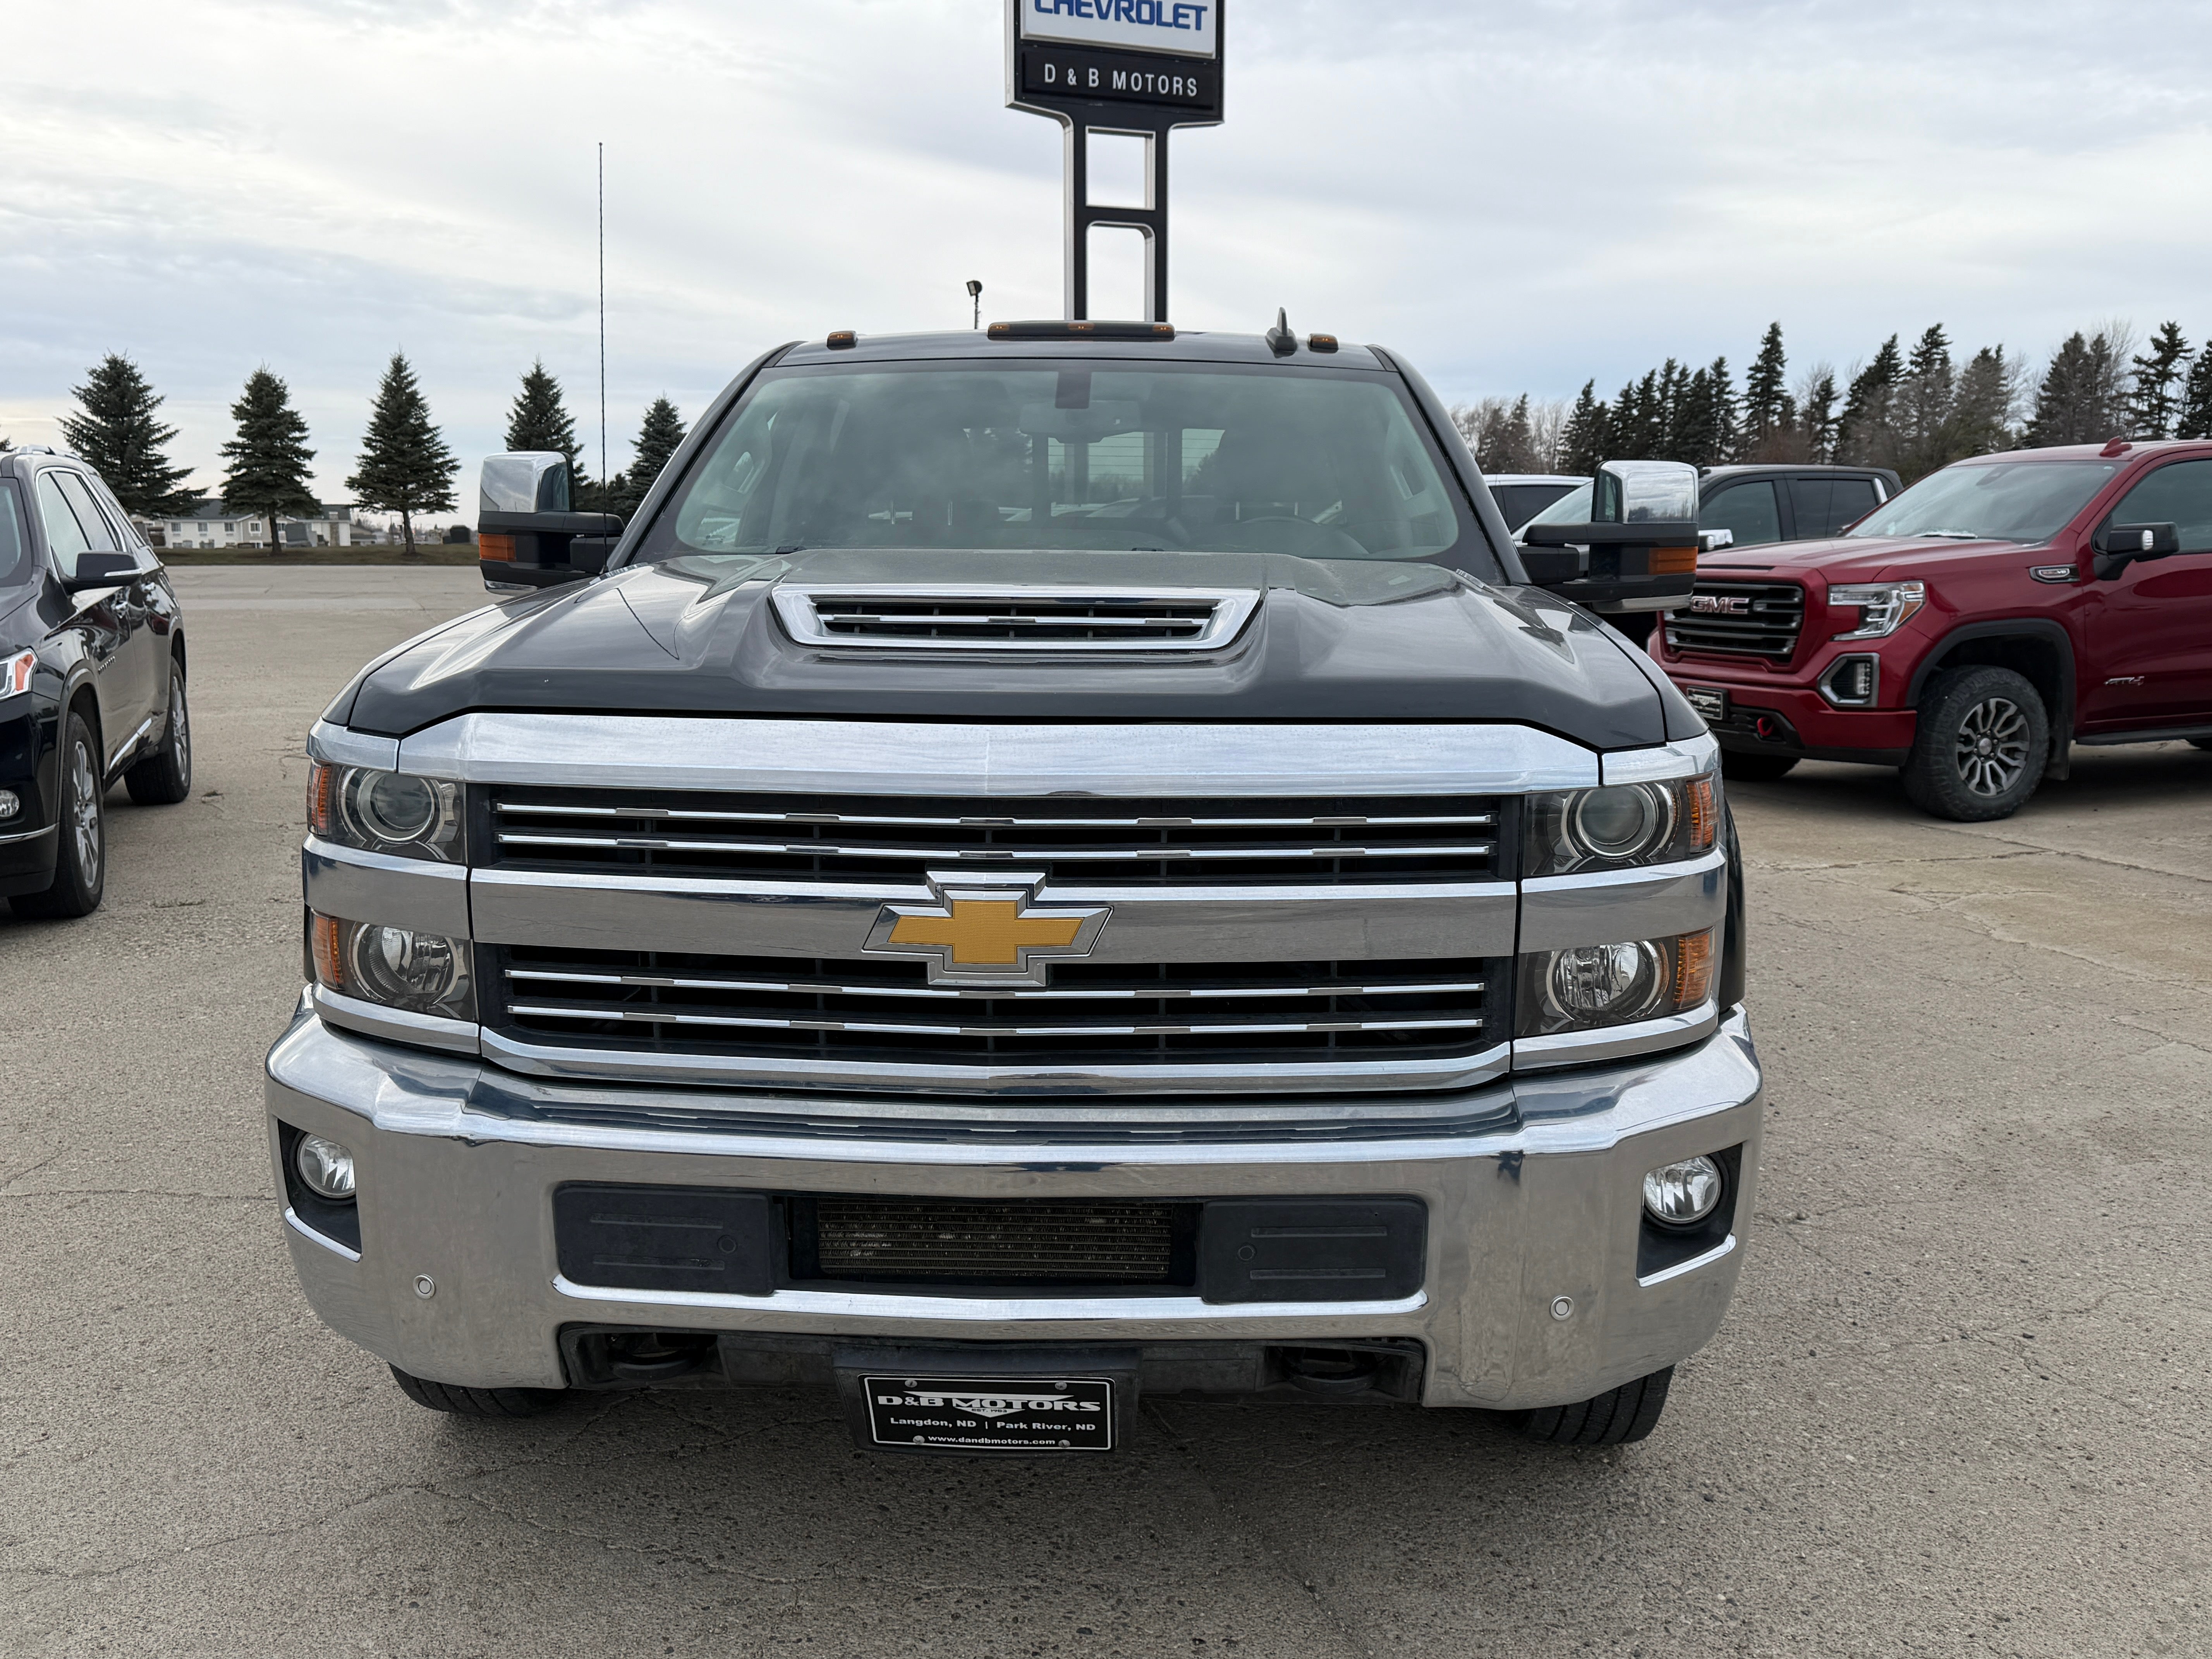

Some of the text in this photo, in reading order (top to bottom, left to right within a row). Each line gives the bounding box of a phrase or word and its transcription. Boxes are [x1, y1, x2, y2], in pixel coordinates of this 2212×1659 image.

[1035, 0, 1207, 31] CHEVROLET
[1044, 64, 1197, 96] D & B MOTORS
[1691, 596, 1749, 614] GMC
[878, 1396, 1101, 1411] D&B MOTORS
[890, 1417, 952, 1428] Langdon,
[1032, 1423, 1071, 1431] River,
[928, 1436, 1055, 1444] www.dandbmotors.com
